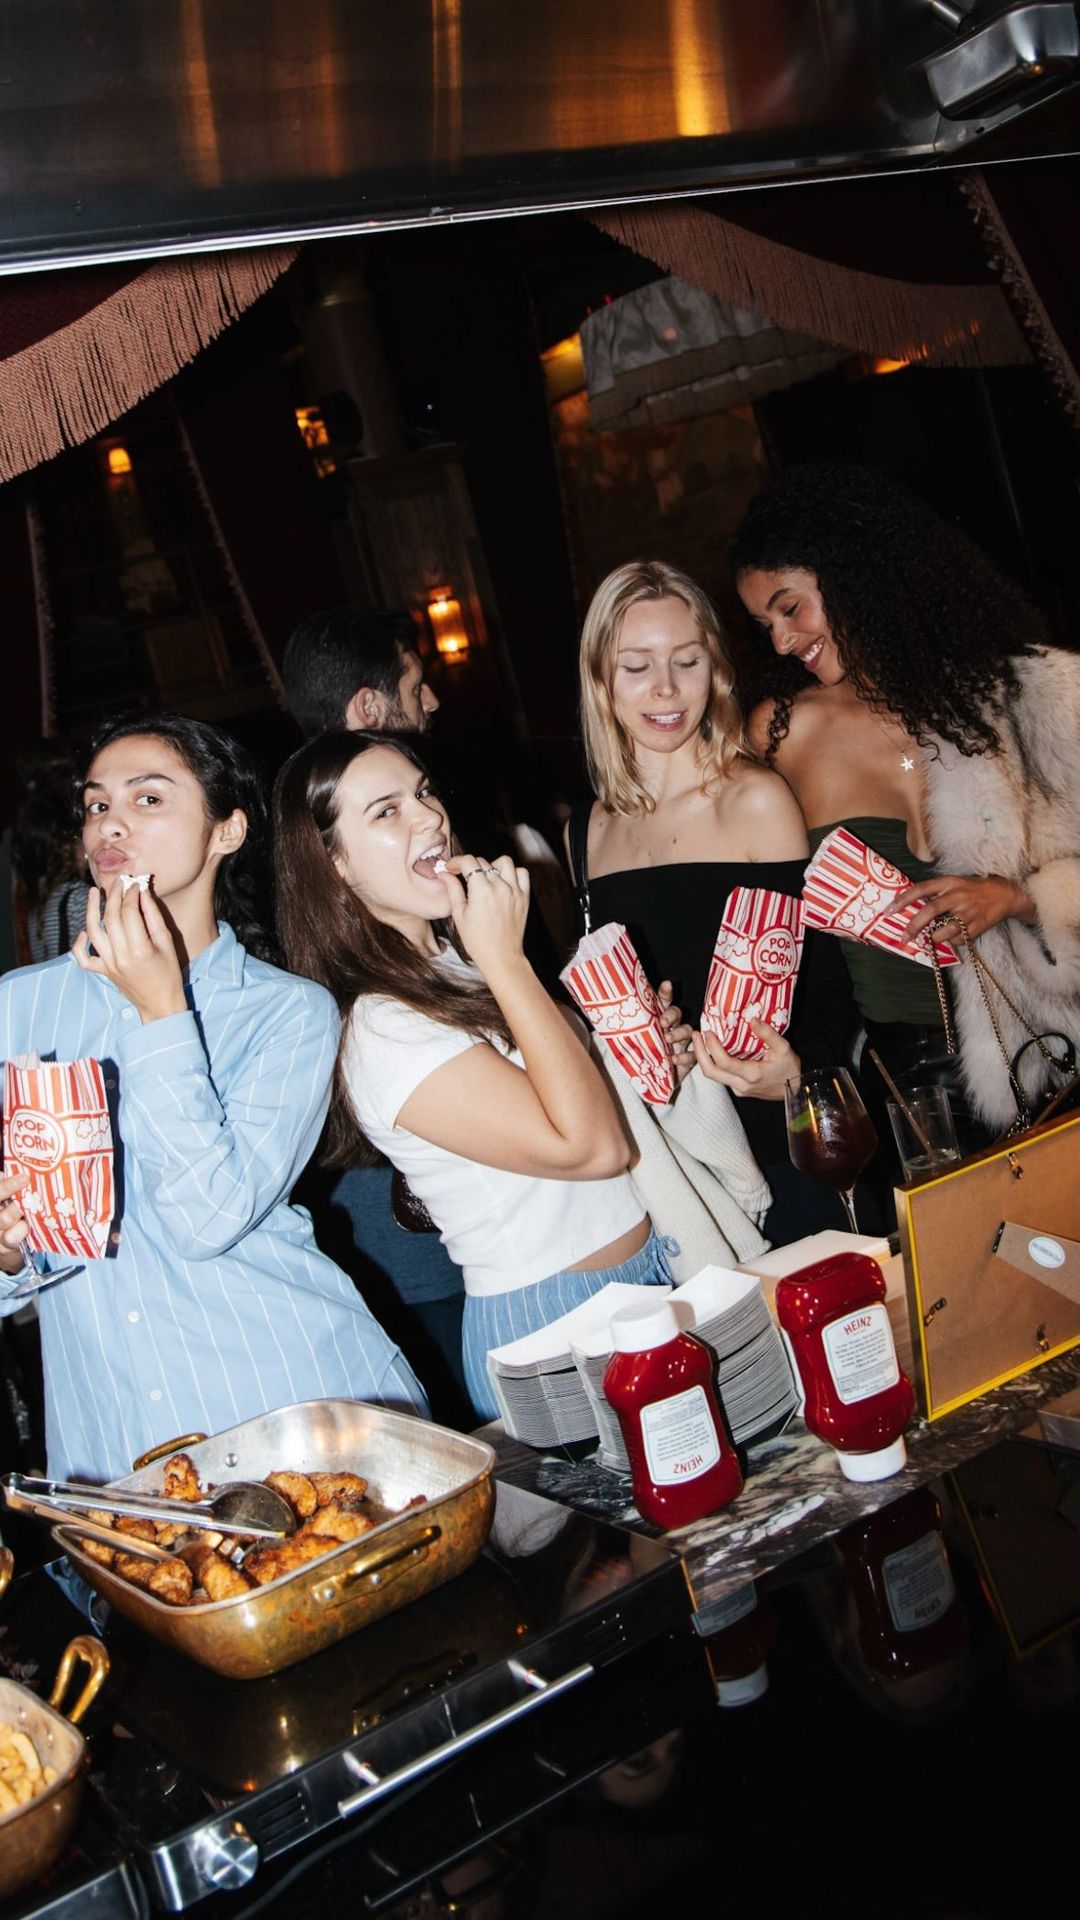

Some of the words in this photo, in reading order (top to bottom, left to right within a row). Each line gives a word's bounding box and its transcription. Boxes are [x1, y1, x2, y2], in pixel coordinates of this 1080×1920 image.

[770, 937, 791, 951] POP
[760, 949, 792, 967] CORN
[16, 1119, 46, 1133] POP
[15, 1133, 55, 1151] CORN
[843, 1316, 871, 1335] HEINZ
[673, 1454, 703, 1474] HEINZ
